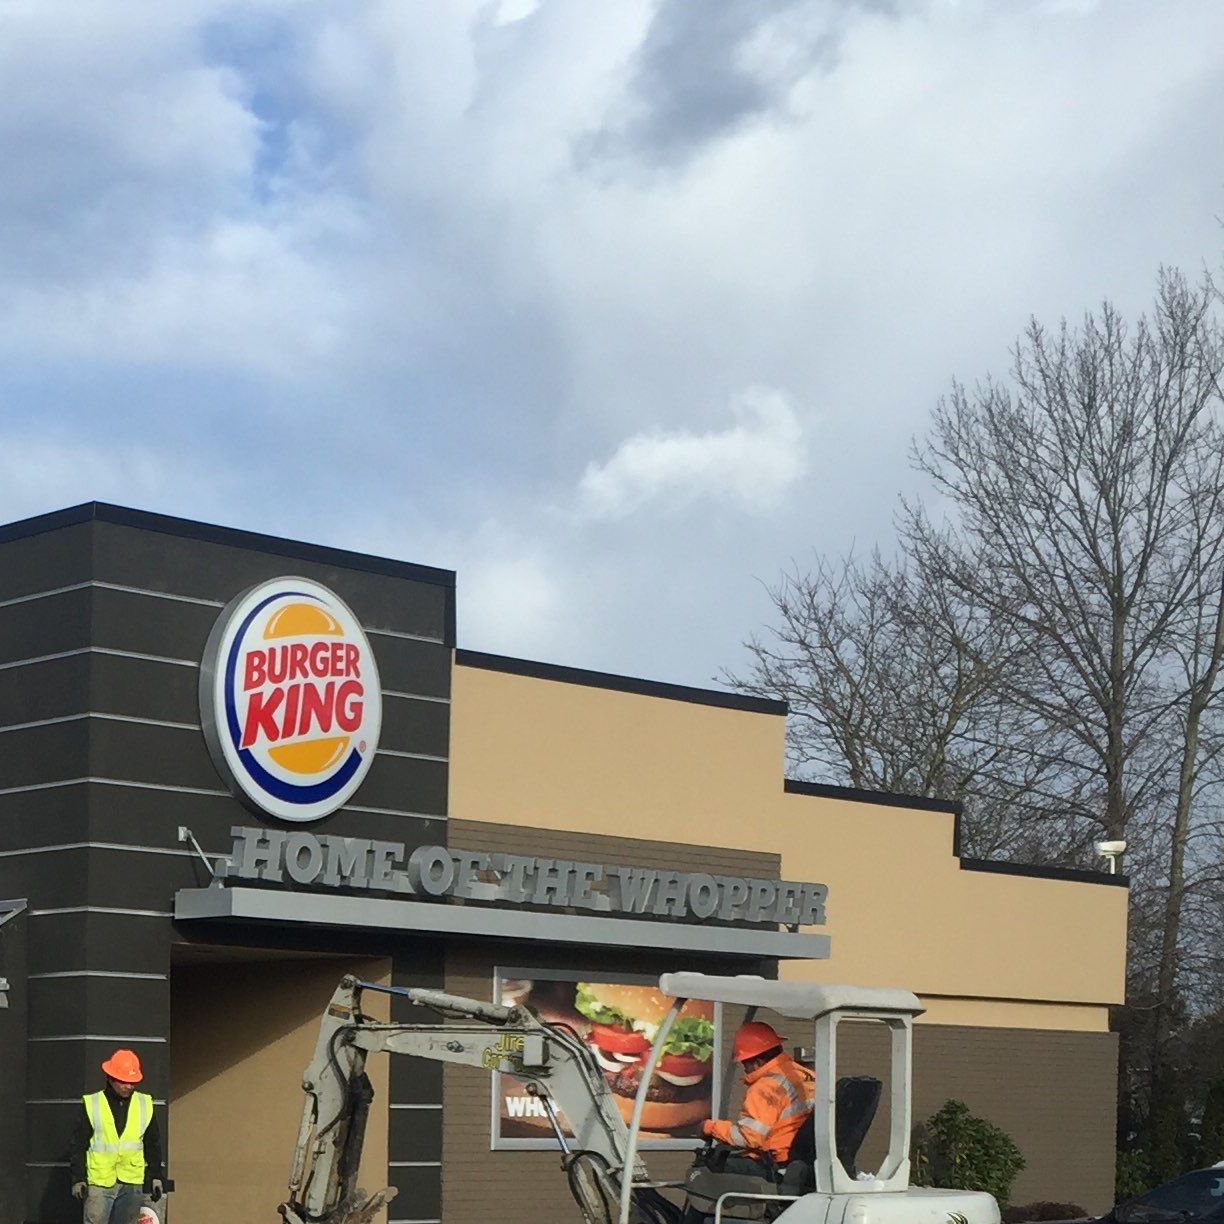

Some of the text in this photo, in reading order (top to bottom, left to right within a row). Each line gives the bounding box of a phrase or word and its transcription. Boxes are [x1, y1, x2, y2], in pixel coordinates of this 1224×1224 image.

[243, 641, 362, 692] BURGER
[241, 680, 365, 748] KING
[232, 826, 828, 926] HOME OF THE WHOPPER
[496, 1033, 524, 1051] Jire
